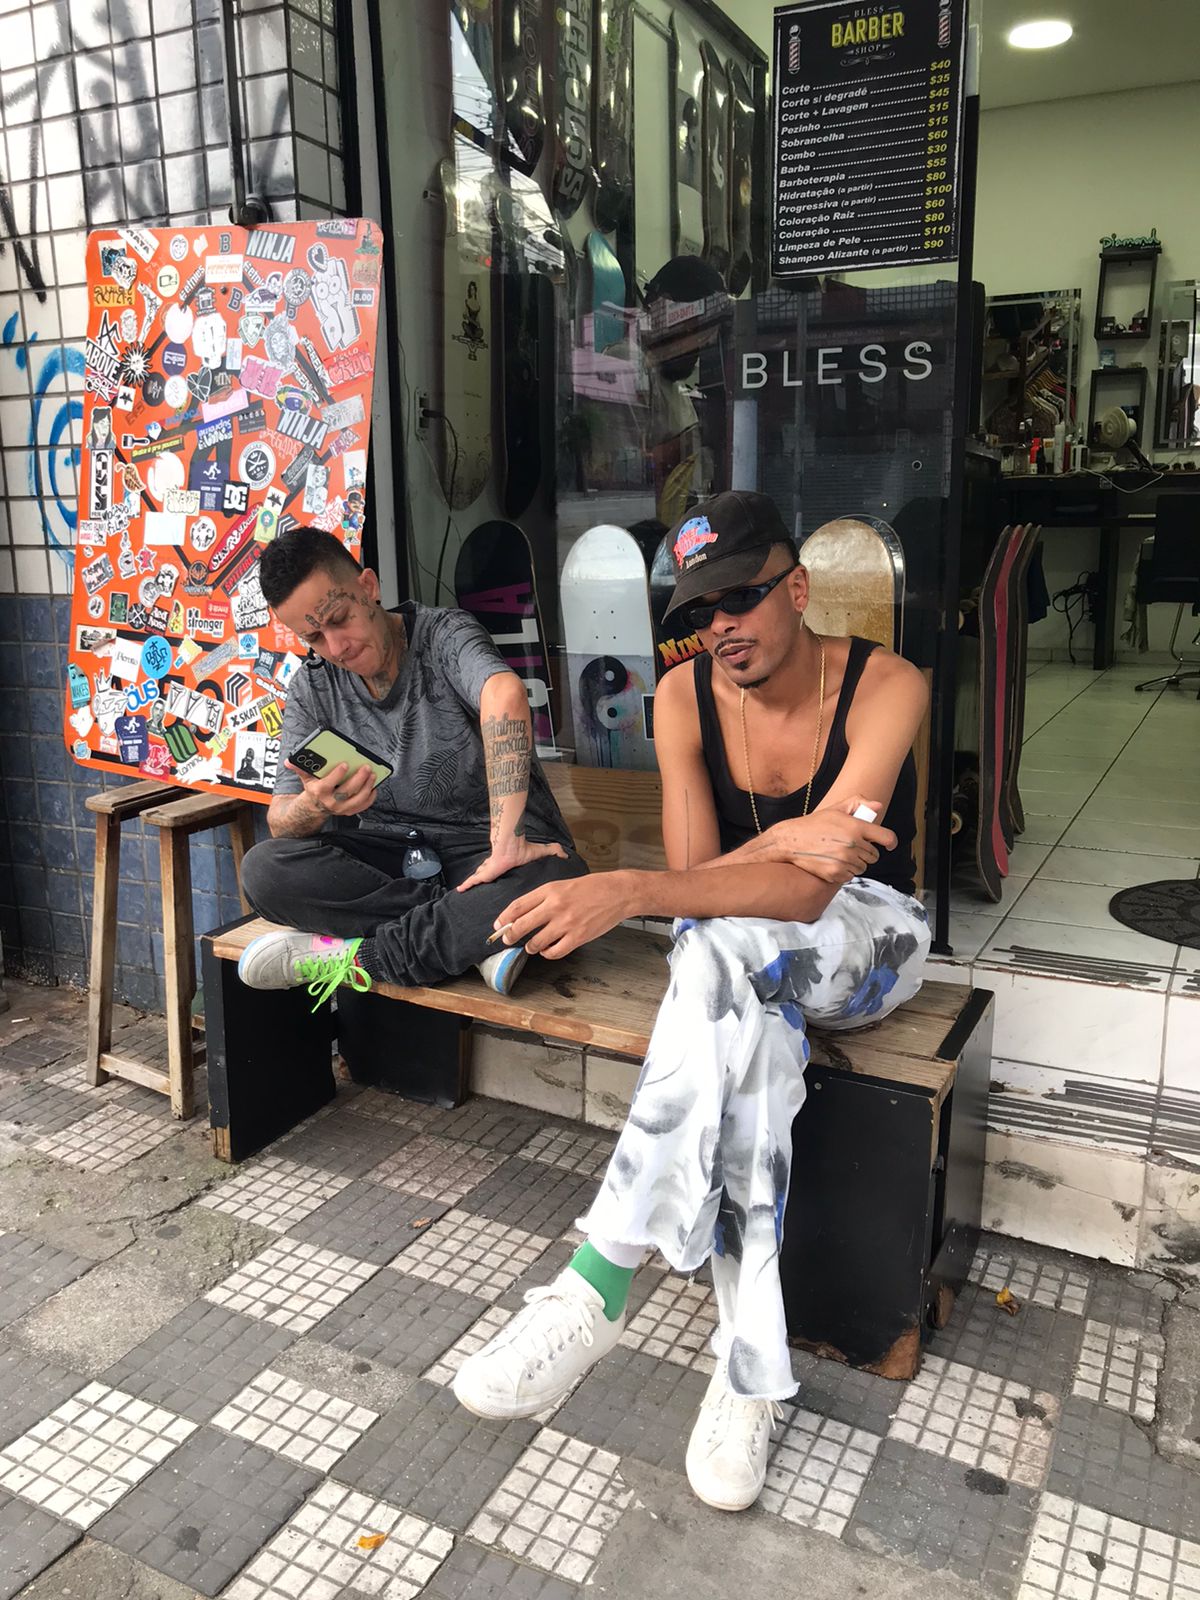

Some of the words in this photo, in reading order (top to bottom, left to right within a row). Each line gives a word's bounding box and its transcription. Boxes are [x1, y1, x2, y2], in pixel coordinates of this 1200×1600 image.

[854, 5, 885, 18] BLESS
[831, 11, 905, 49] BARBER
[855, 44, 882, 55] SHOP
[781, 84, 811, 95] Corte
[930, 59, 951, 71] $40
[781, 98, 811, 109] Corte
[812, 94, 823, 104] s/
[824, 87, 868, 102] degradé
[929, 73, 950, 85] $35
[780, 123, 821, 135] Pezinho
[928, 101, 949, 113] $15
[781, 111, 810, 122] Corte
[821, 102, 869, 116] Lavagem
[929, 87, 950, 99] $45
[780, 133, 845, 149] Sobrancelha
[927, 115, 949, 127] $15
[780, 150, 816, 161] Combo
[927, 129, 948, 141] $60
[779, 172, 846, 188] Barboterapia
[926, 157, 947, 169] $55
[780, 164, 811, 175] Barba
[926, 143, 948, 155] $30
[779, 187, 835, 201] Hidratação
[837, 187, 846, 195] (a
[847, 183, 874, 194] partir)
[925, 171, 946, 183] $80
[779, 200, 839, 214] Progressiva
[841, 200, 849, 208] (a
[850, 196, 877, 206] partir)
[925, 184, 952, 196] $100
[779, 213, 830, 227] Coloração
[924, 198, 945, 210] $60
[779, 227, 830, 240] Coloração
[924, 212, 945, 224] $80
[246, 230, 296, 263] NINJA
[779, 240, 820, 253] Limpeza
[823, 239, 836, 248] de
[838, 236, 861, 246] Pele
[923, 224, 951, 236] $110
[779, 253, 825, 265] Shampoo
[827, 248, 869, 260] Alizante
[871, 248, 880, 256] (a
[881, 244, 909, 256] partir)
[923, 238, 944, 250] $90
[1101, 228, 1161, 249] Diamond
[742, 340, 933, 389] BLESS
[278, 411, 329, 450] NINJA
[223, 484, 248, 512] DC
[224, 556, 254, 592] SPITFIRE
[685, 553, 708, 570] London
[147, 618, 168, 632] Nose
[150, 606, 169, 621] Red
[187, 616, 223, 632] stronger
[658, 633, 705, 667] NIN
[263, 738, 281, 788] BARS
